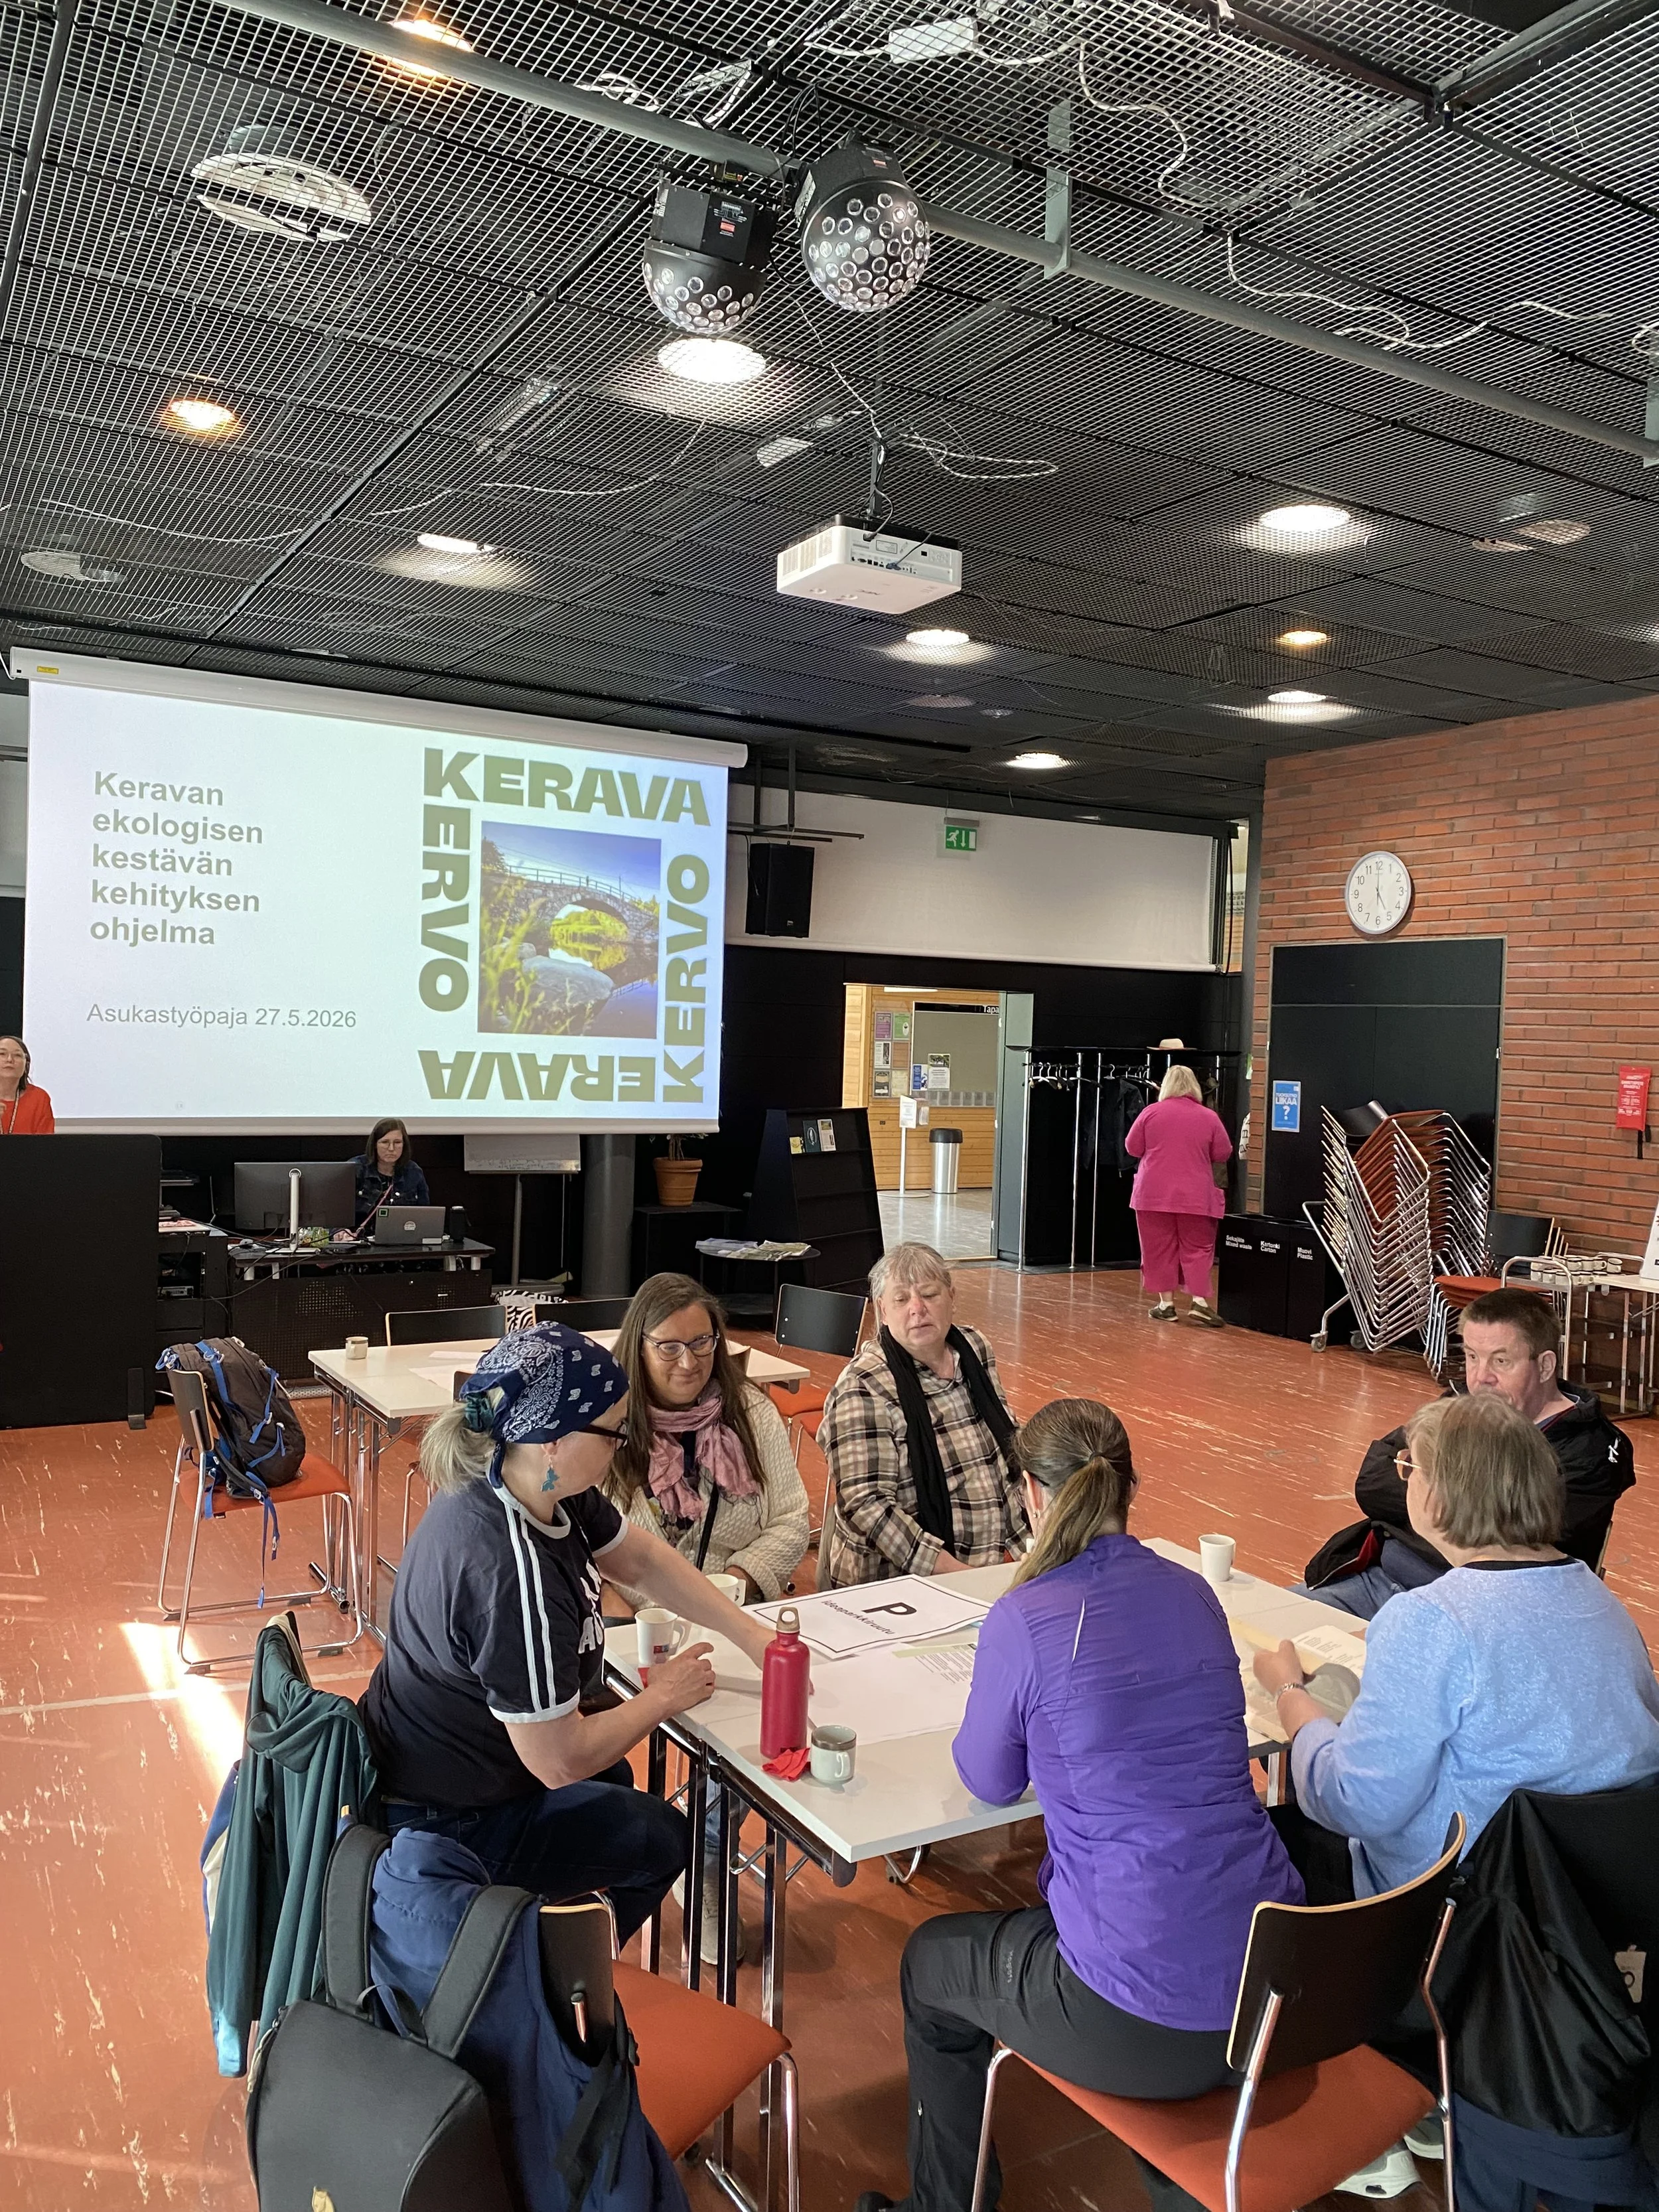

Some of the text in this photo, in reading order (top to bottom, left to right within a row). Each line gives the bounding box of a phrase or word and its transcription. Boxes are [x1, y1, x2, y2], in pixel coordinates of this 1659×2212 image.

[94, 771, 224, 806] Keravan
[424, 747, 710, 826] KERAVA
[92, 809, 263, 845] ekologisen
[92, 844, 232, 876] kestävän
[1366, 865, 1372, 875] 11
[1375, 861, 1383, 870] 12
[1389, 863, 1392, 873] 1
[1357, 875, 1364, 885] 10
[1396, 873, 1402, 882] 2
[1354, 889, 1359, 899] 9
[1398, 887, 1404, 896] 3
[92, 879, 260, 915] kehityksen
[1358, 903, 1363, 913] 8
[1395, 901, 1400, 910] 4
[1365, 913, 1370, 922] 7
[1375, 916, 1380, 925] 6
[1386, 911, 1392, 921] 5
[90, 917, 215, 948] ohjelma
[86, 1003, 356, 1029] Asukastyöpaja 27.5.2026
[1275, 1097, 1297, 1106] LIIKAA
[1283, 1105, 1290, 1120] ?
[1260, 1240, 1280, 1249] Kartonki
[861, 1601, 917, 1615] P
[821, 1599, 895, 1635] ideaparkkiruutu
